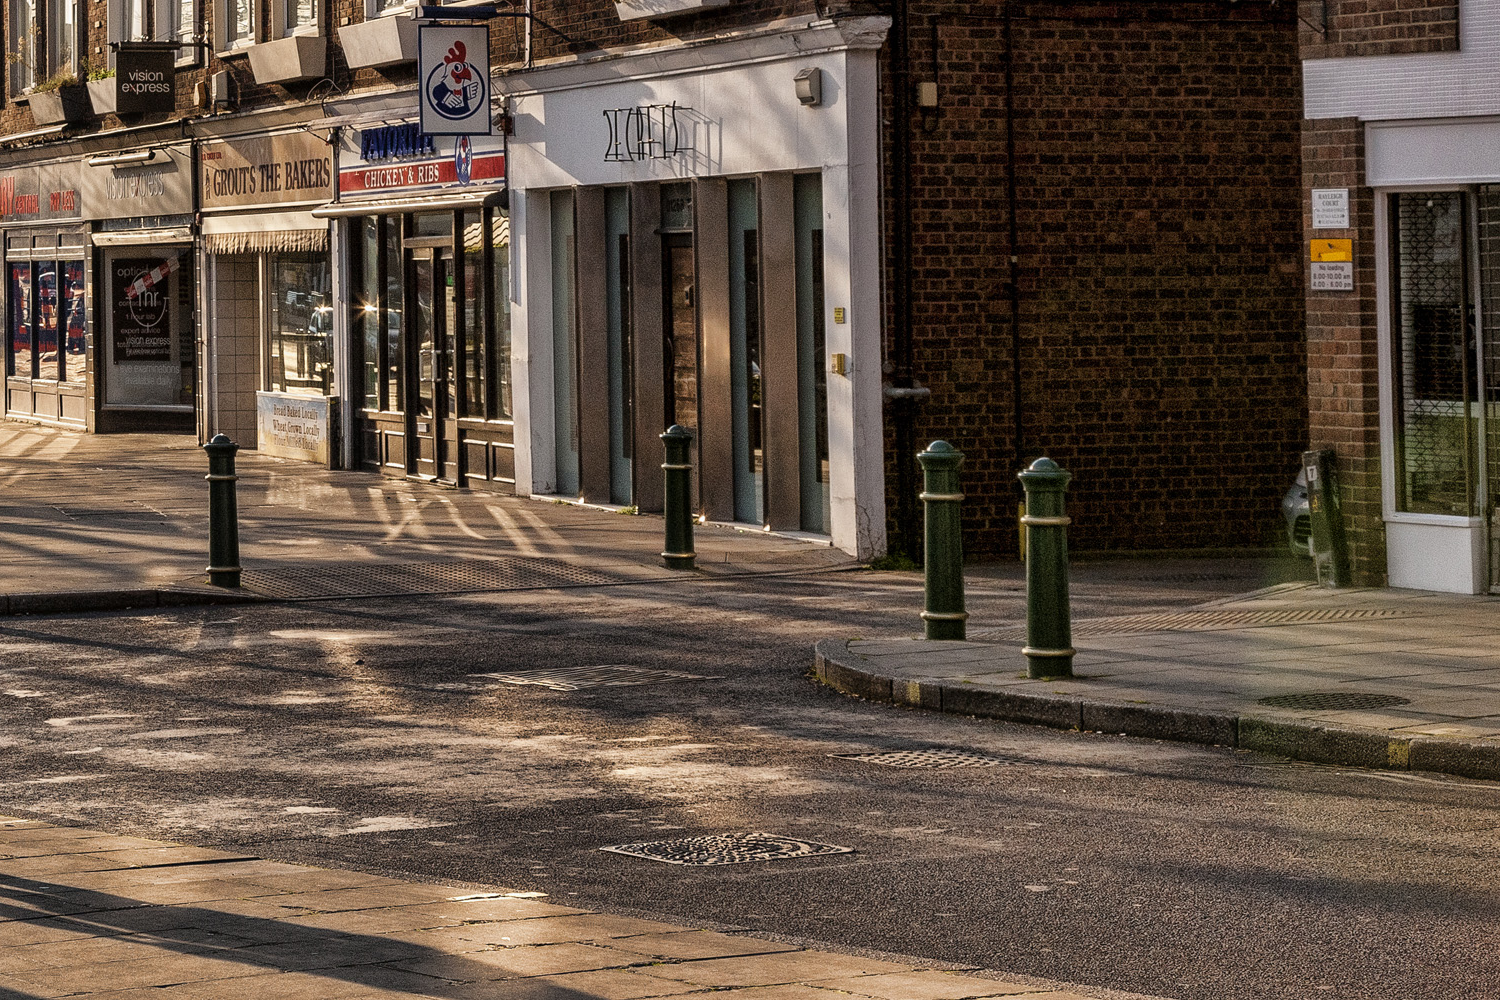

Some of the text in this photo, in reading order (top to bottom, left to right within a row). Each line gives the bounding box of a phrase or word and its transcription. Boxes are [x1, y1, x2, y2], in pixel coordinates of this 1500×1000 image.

[128, 69, 164, 81] vision
[121, 82, 170, 95] express
[258, 163, 282, 192] THE
[285, 157, 330, 190] BAKERS
[364, 164, 440, 188] CHICKEN & RIBS
[105, 170, 165, 205] vision express
[62, 190, 75, 211] LESS
[301, 406, 318, 423] Locally
[303, 422, 320, 439] Locally
[1309, 468, 1314, 479] 7
